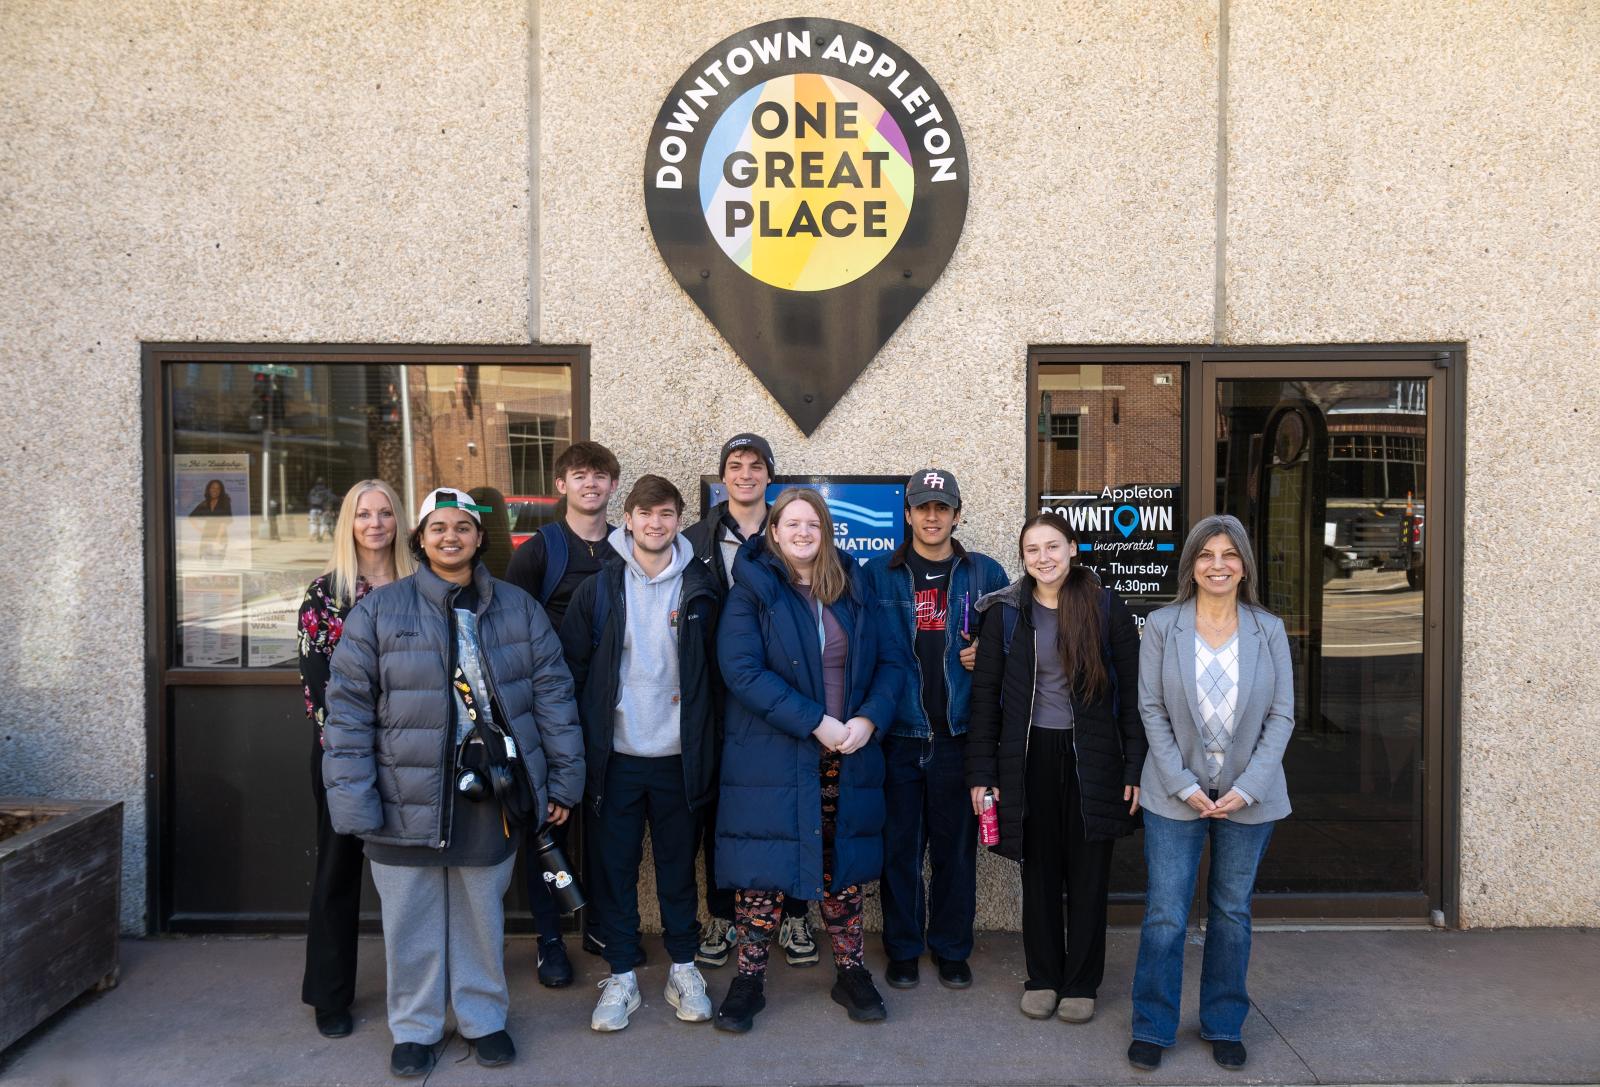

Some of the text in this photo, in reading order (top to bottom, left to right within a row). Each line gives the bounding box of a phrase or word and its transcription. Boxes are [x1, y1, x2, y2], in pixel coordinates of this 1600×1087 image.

[656, 30, 957, 190] DOWNTOWN APPLETON
[751, 101, 859, 139] ONE
[722, 151, 890, 189] GREAT
[725, 200, 887, 238] PLACE
[1100, 485, 1173, 502] Appleton
[833, 537, 895, 551] MATION
[1093, 539, 1155, 557] incorporated
[1109, 562, 1169, 577] Thursday
[1114, 579, 1160, 594] 4:30pm
